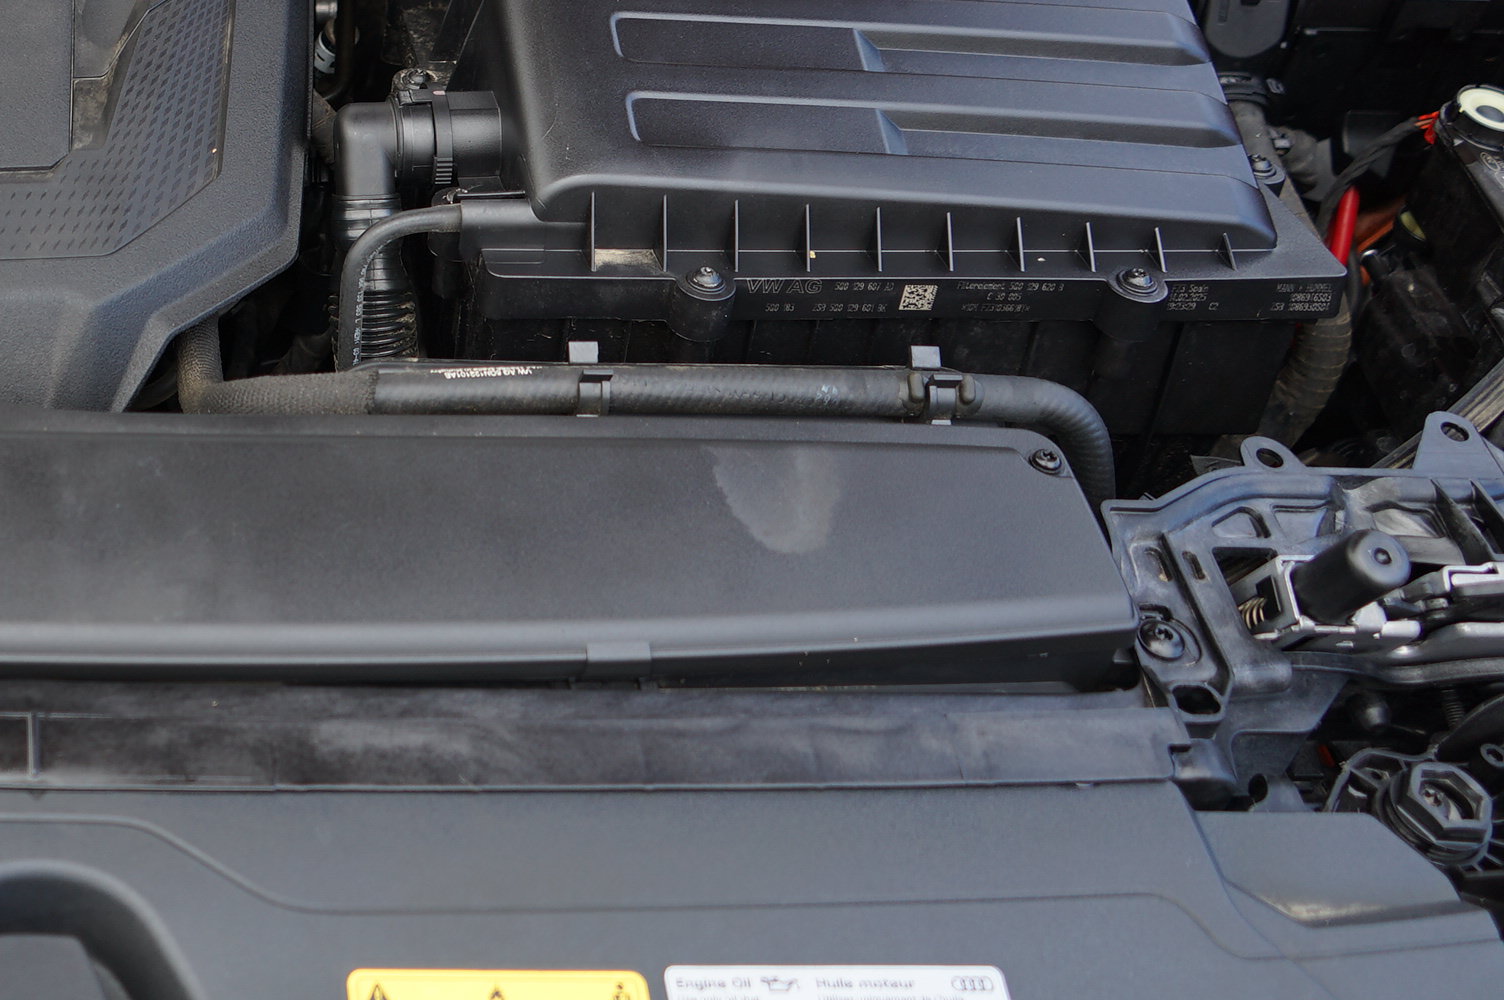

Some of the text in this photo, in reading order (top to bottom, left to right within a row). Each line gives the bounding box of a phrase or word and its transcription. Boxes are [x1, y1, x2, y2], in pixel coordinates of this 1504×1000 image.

[746, 279, 823, 294] VW AG
[1188, 284, 1209, 293] Spain
[675, 976, 751, 990] Engine Oil
[815, 976, 915, 988] Huile moteur
